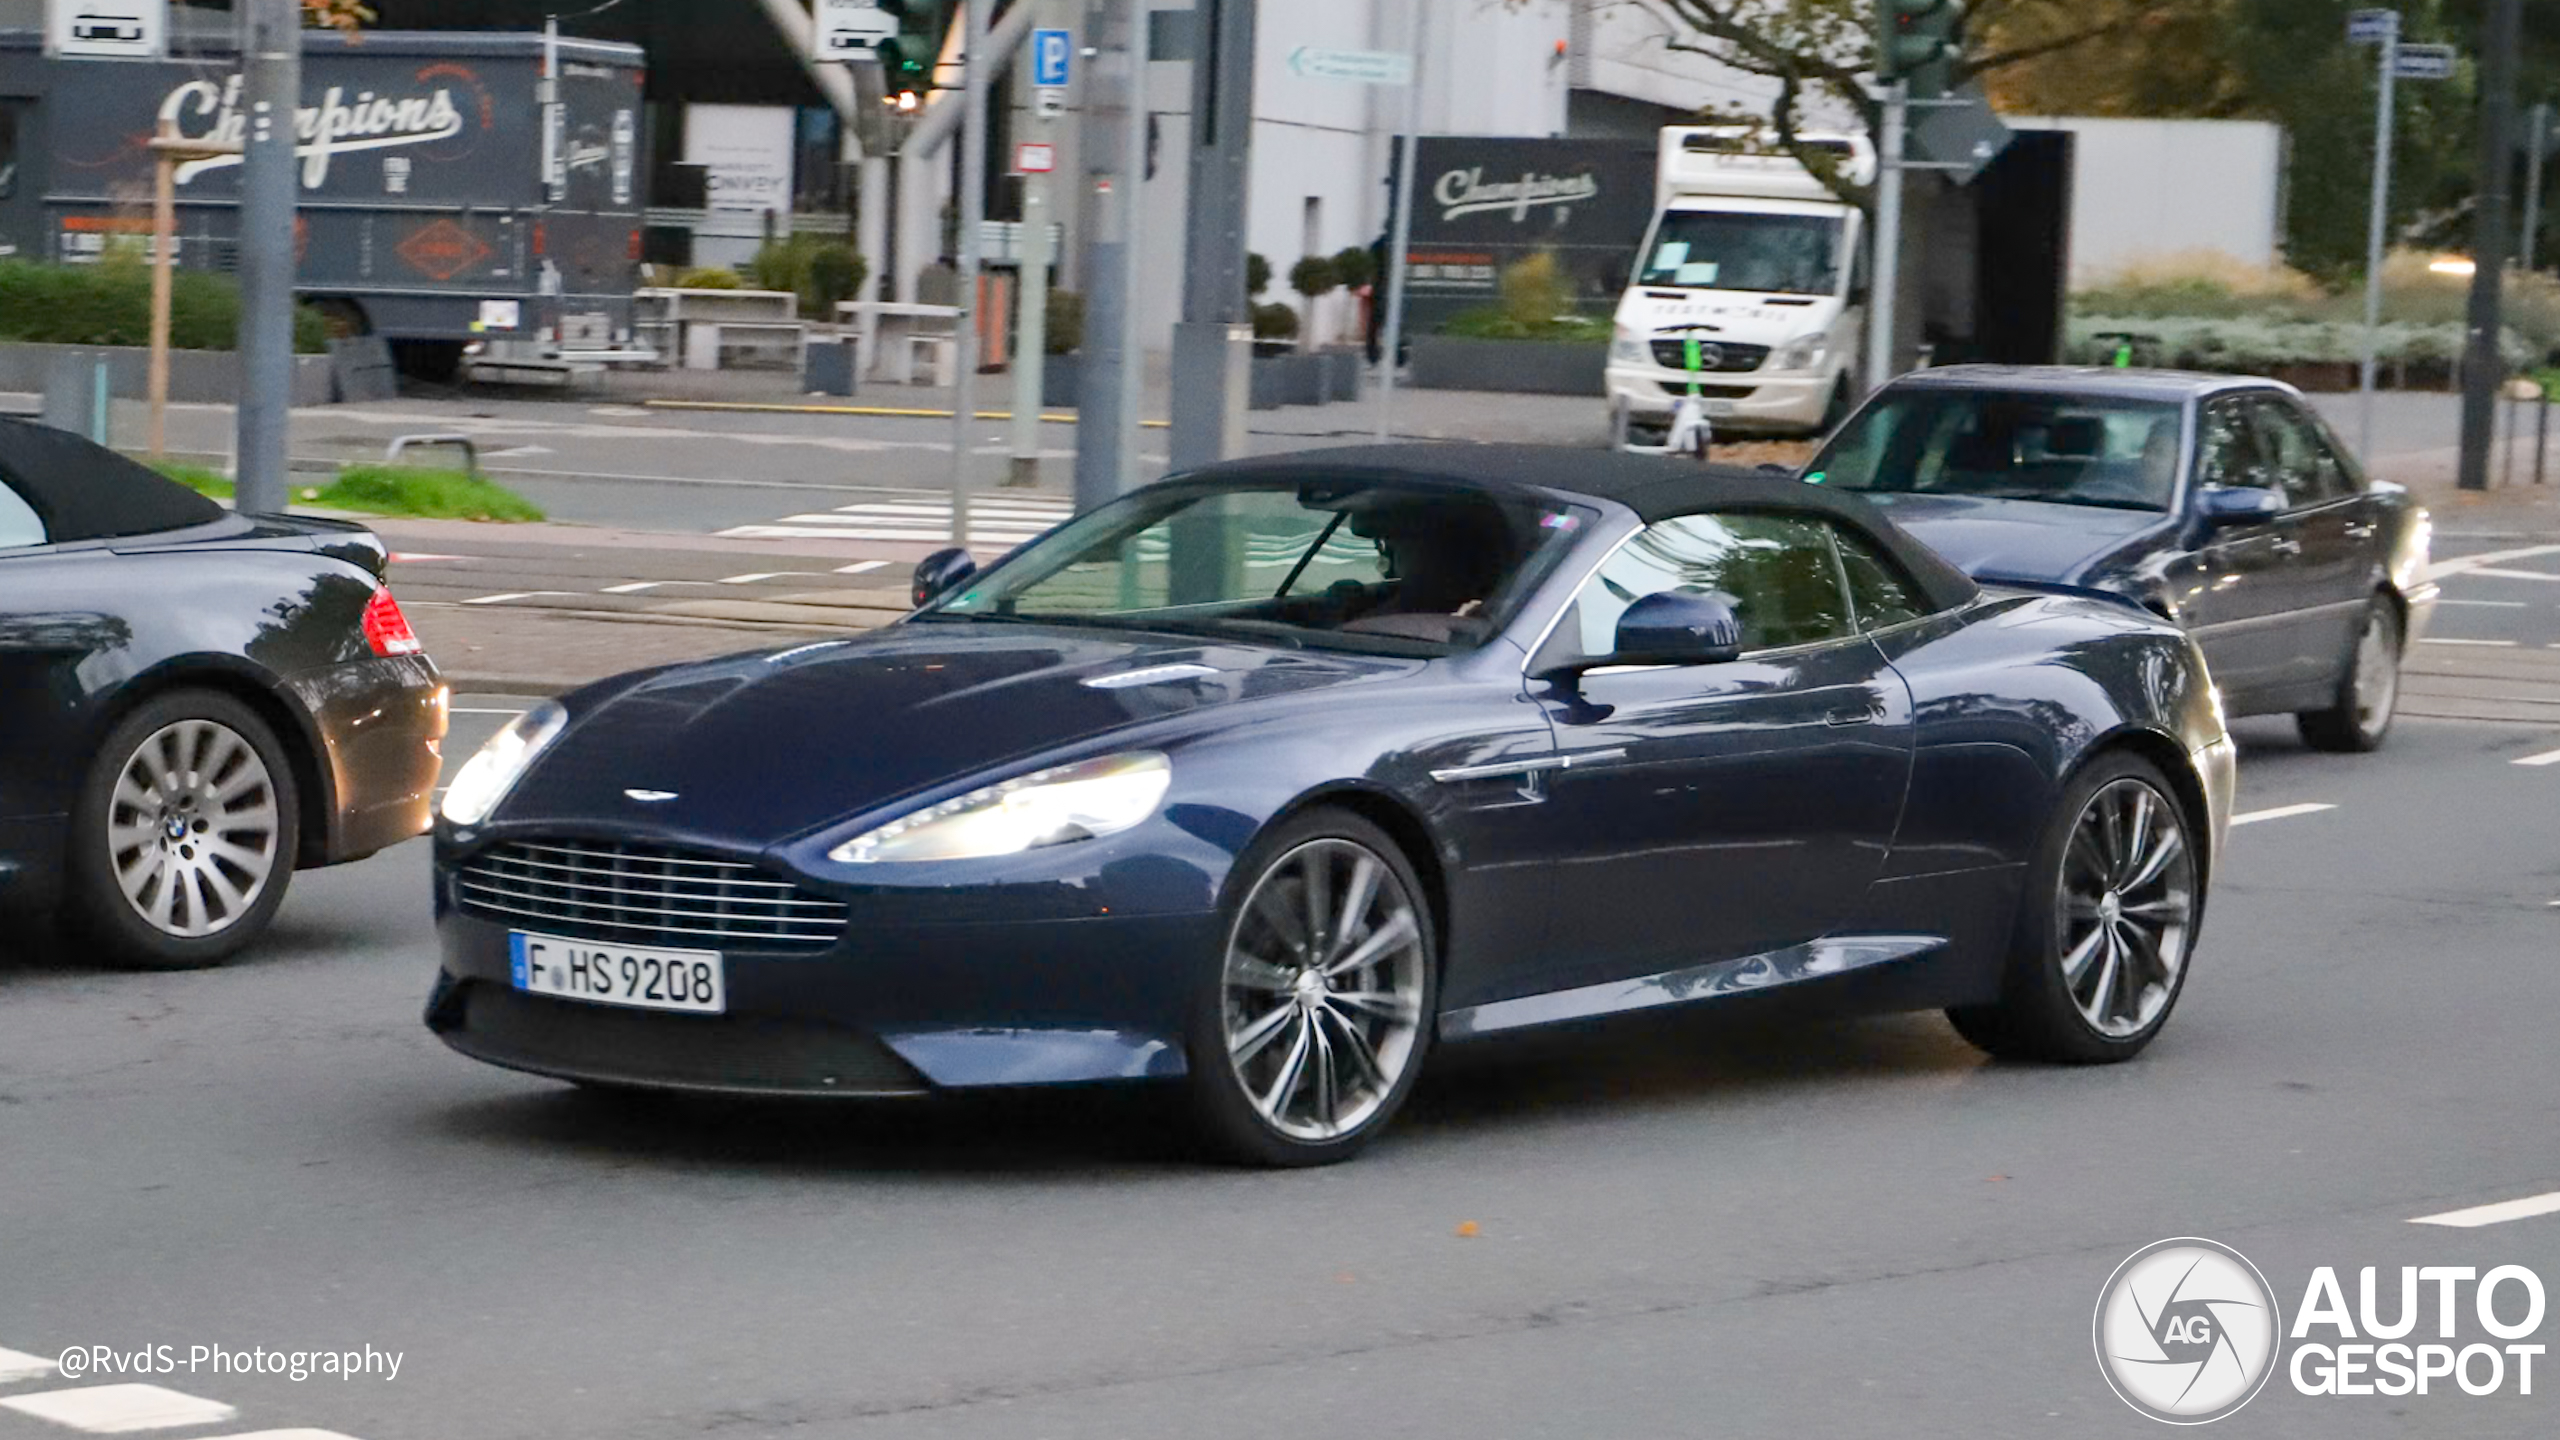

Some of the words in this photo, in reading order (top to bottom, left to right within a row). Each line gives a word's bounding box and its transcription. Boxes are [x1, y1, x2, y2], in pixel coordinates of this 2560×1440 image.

[1044, 36, 1066, 78] P
[530, 944, 546, 984] F
[569, 949, 612, 994] HS
[621, 956, 714, 1004] 9208
